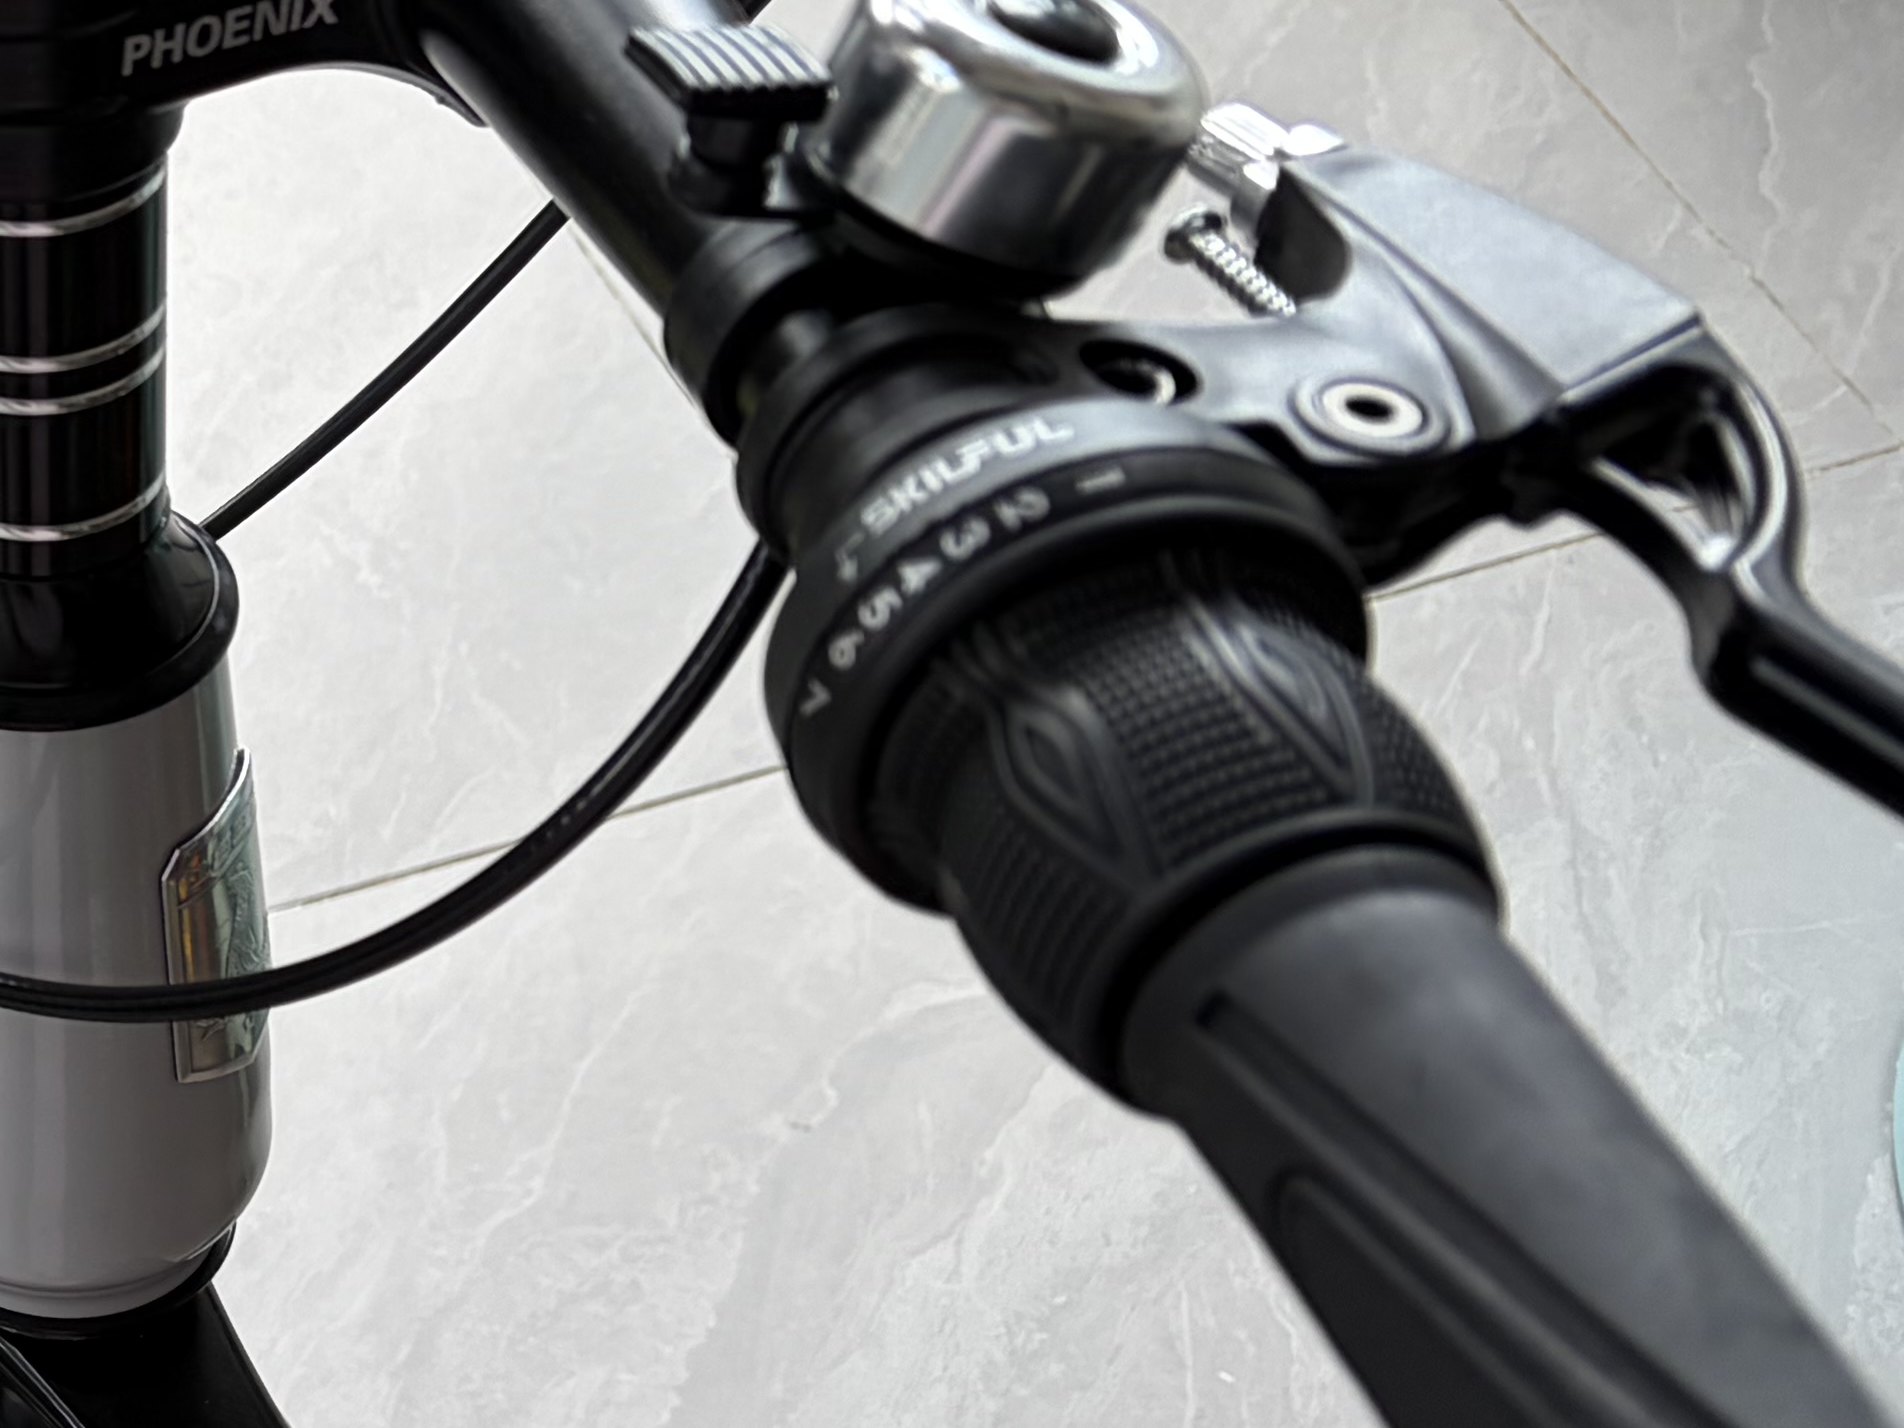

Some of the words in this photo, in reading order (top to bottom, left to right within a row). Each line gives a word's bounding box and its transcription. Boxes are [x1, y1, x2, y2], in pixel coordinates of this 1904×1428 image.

[994, 485, 1051, 532] 2
[939, 515, 991, 561] 3
[857, 585, 903, 631] 5
